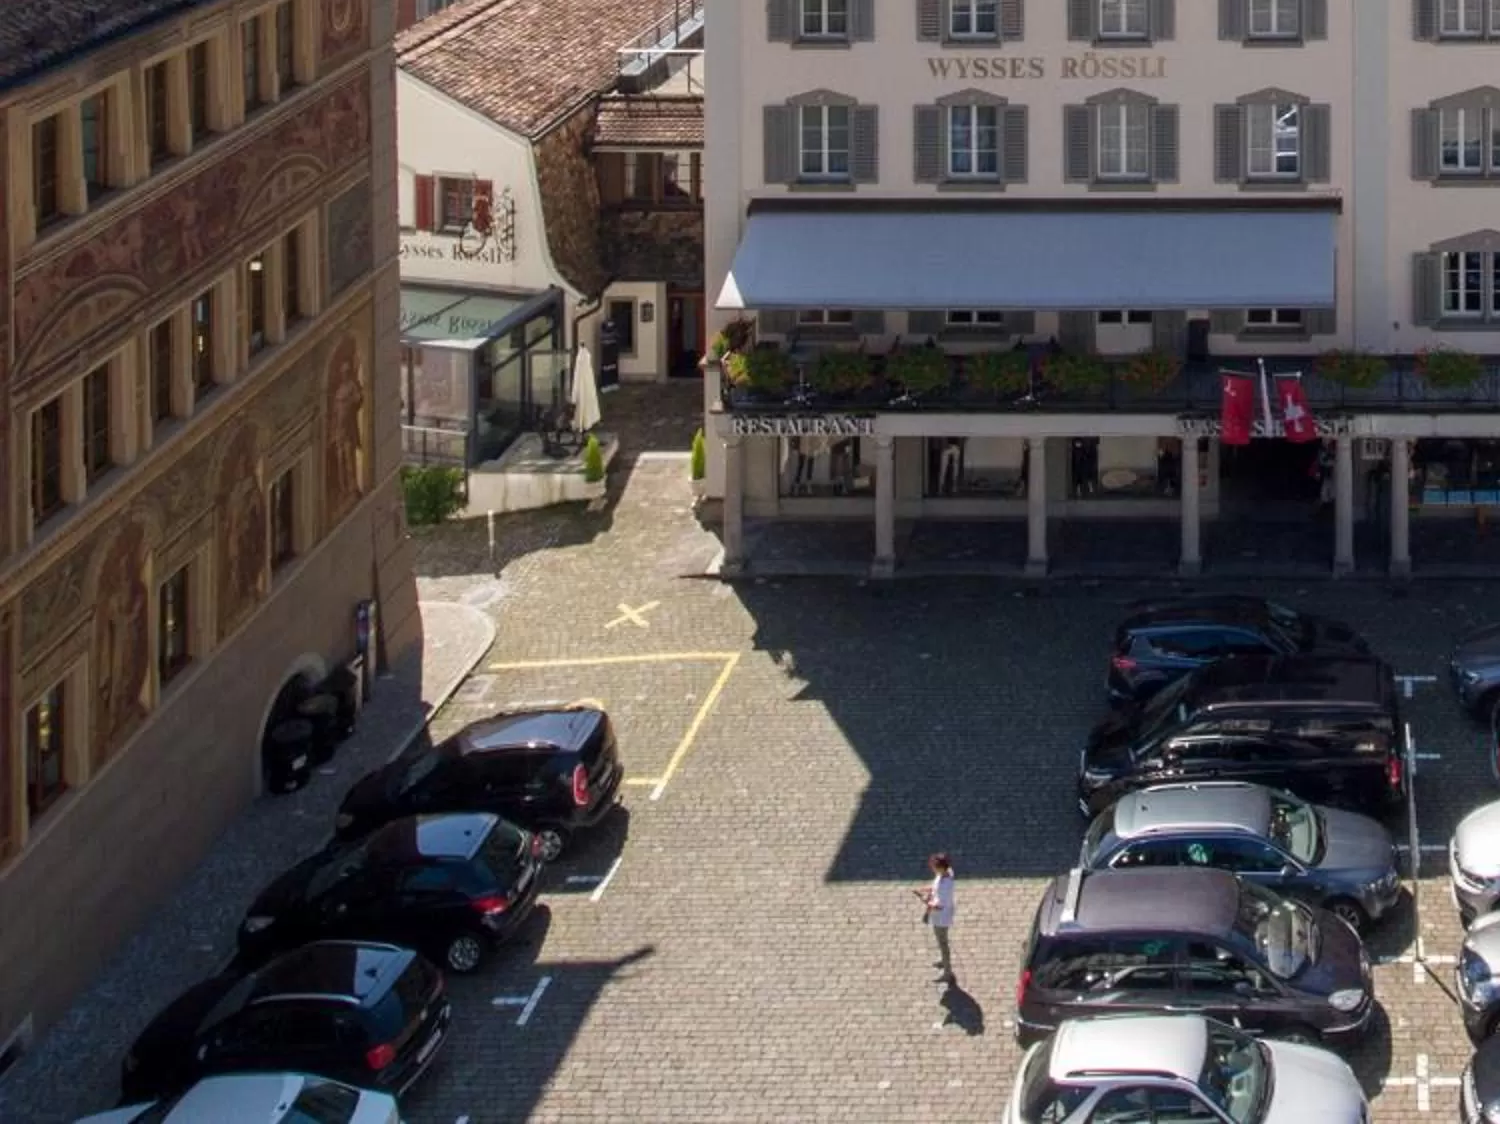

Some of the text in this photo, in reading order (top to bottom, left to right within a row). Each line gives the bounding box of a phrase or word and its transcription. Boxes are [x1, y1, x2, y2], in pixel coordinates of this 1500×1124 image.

[927, 52, 1168, 79] WYSSES RÖSSLI
[399, 243, 444, 260] ysses
[732, 416, 875, 436] RESTAURANT
